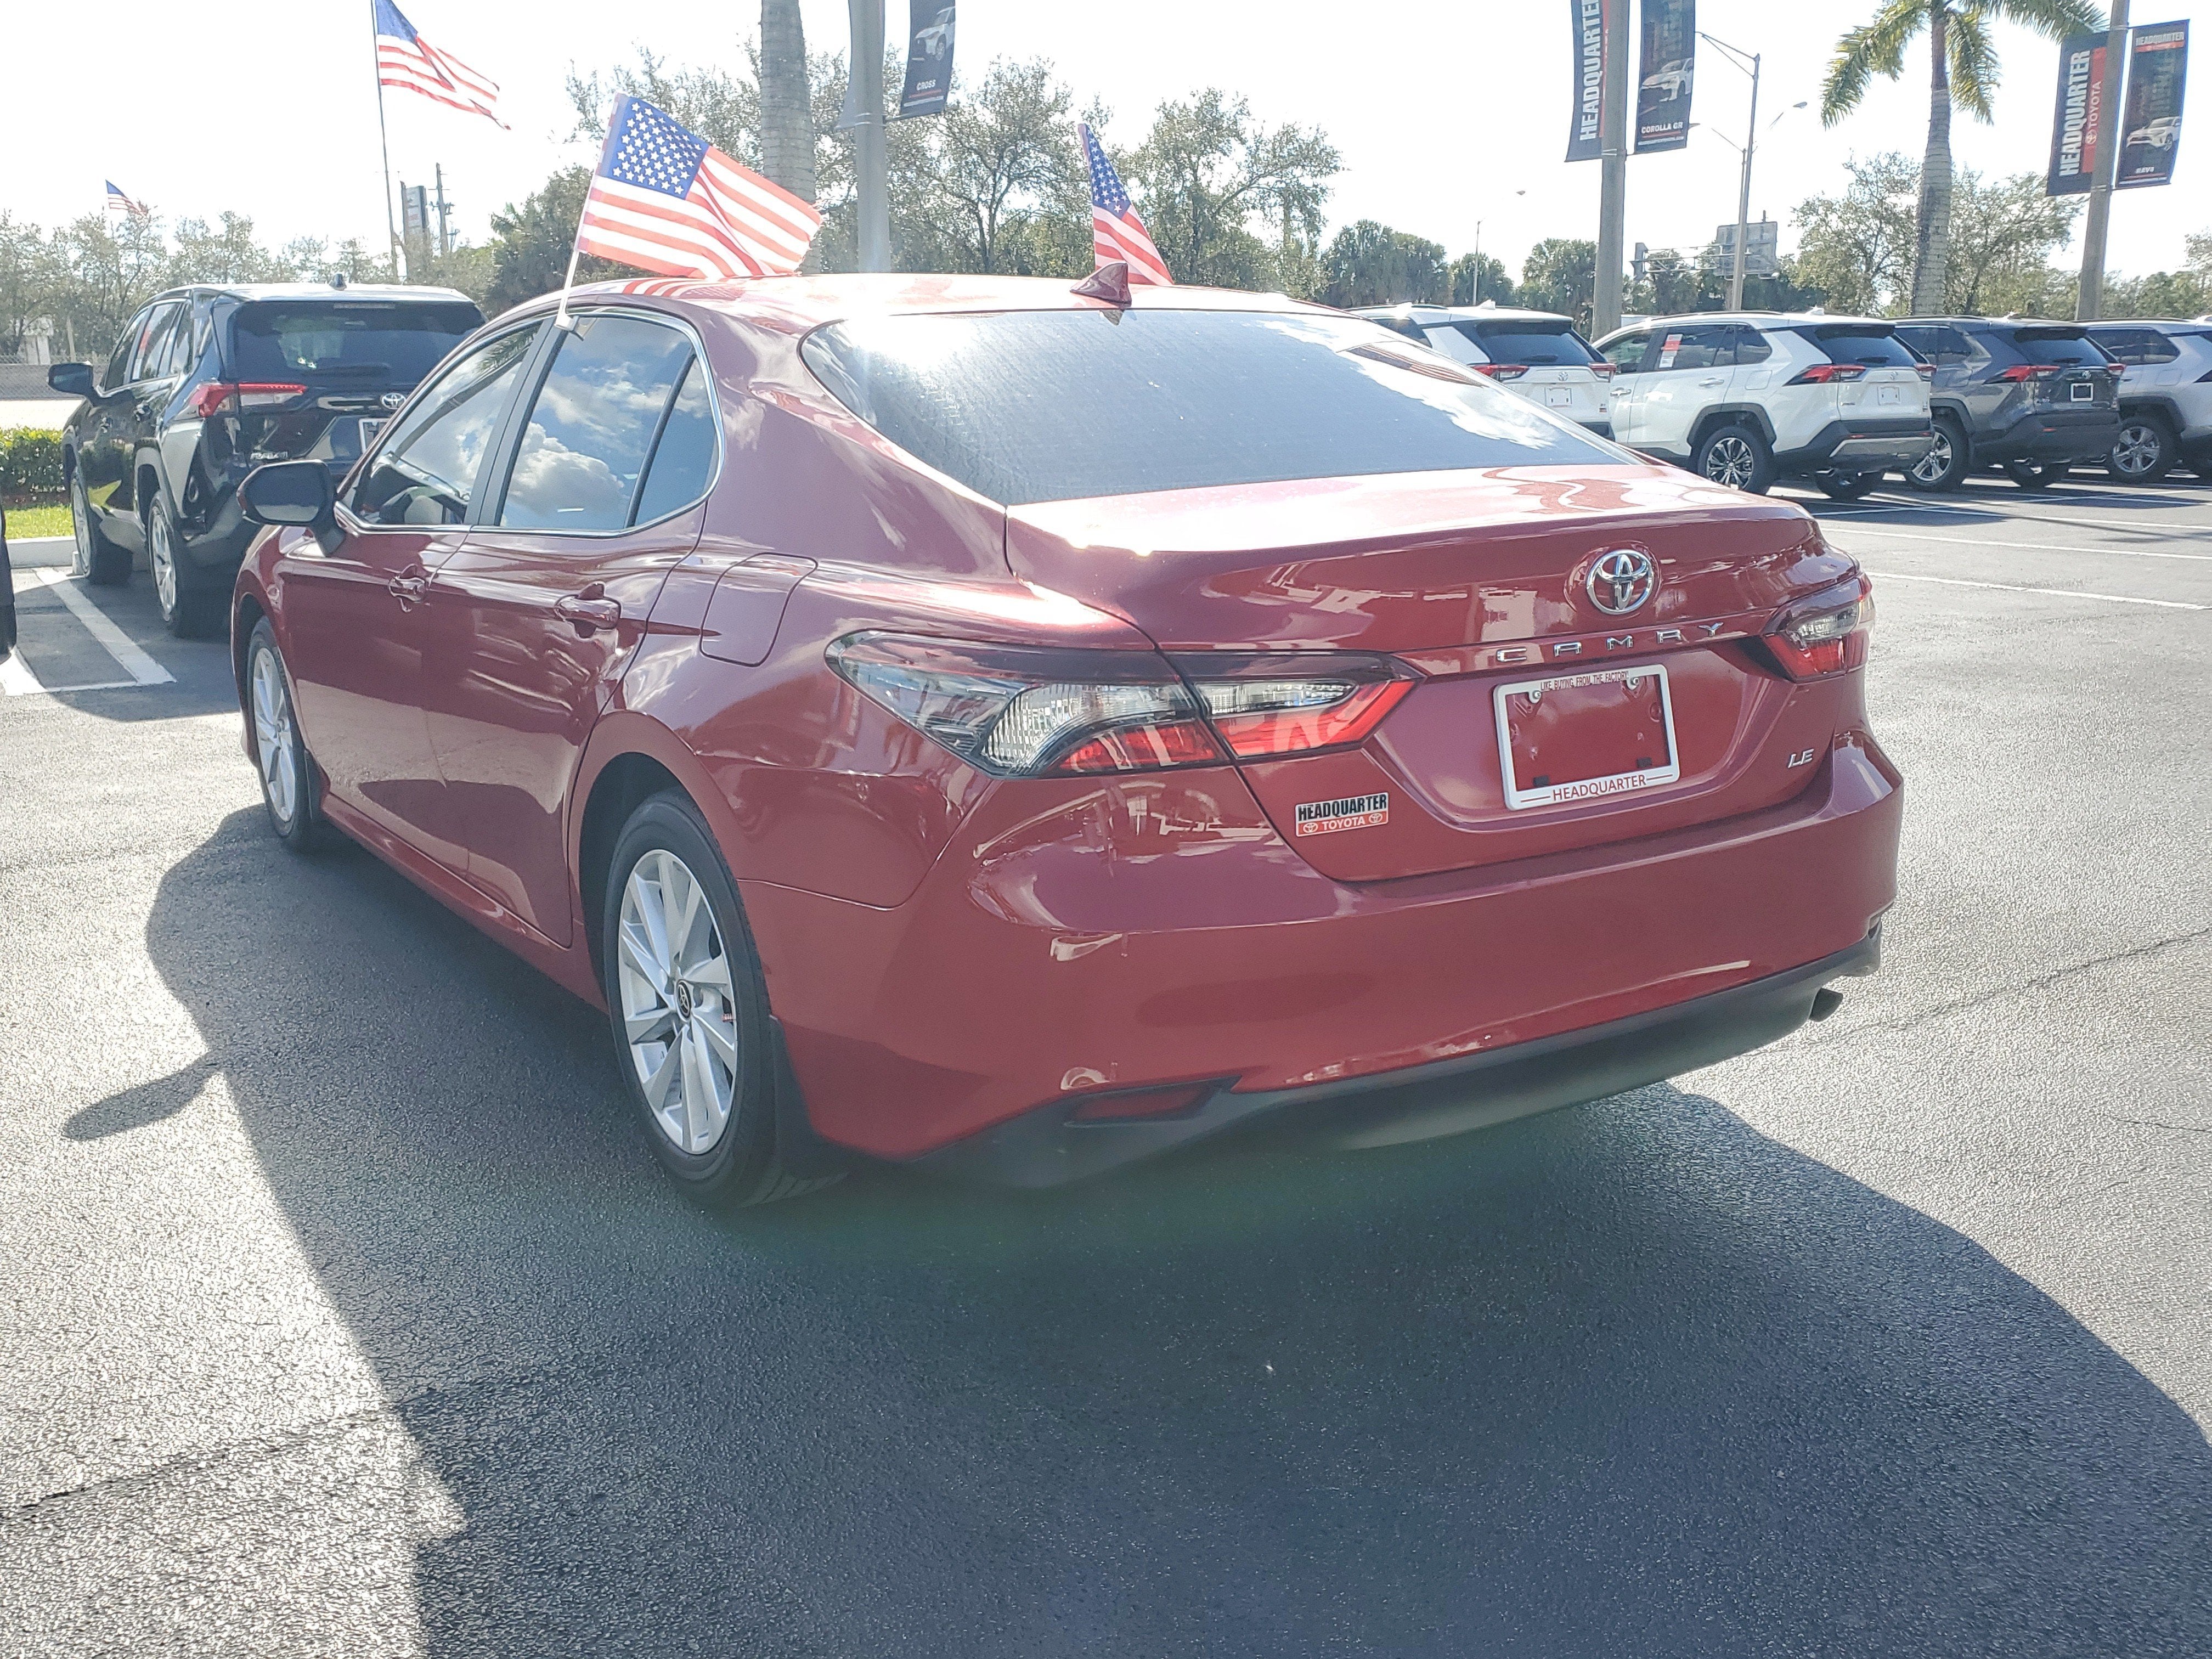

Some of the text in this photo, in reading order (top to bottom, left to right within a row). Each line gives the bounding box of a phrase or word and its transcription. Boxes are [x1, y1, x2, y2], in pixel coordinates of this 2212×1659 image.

[2059, 50, 2090, 177] HEADQUARTER
[2088, 81, 2102, 128] TOYOTA
[1641, 121, 1684, 134] COROLLA GR
[1541, 680, 1553, 690] LIKE
[1554, 678, 1575, 689] BUYING
[1576, 675, 1590, 687] FROM
[1593, 674, 1604, 684] THE
[1787, 748, 1815, 769] LE
[1553, 774, 1646, 801] HEADQUARTER
[1298, 793, 1387, 821] HEADQUARTER
[1322, 816, 1365, 831] TOYOTA
